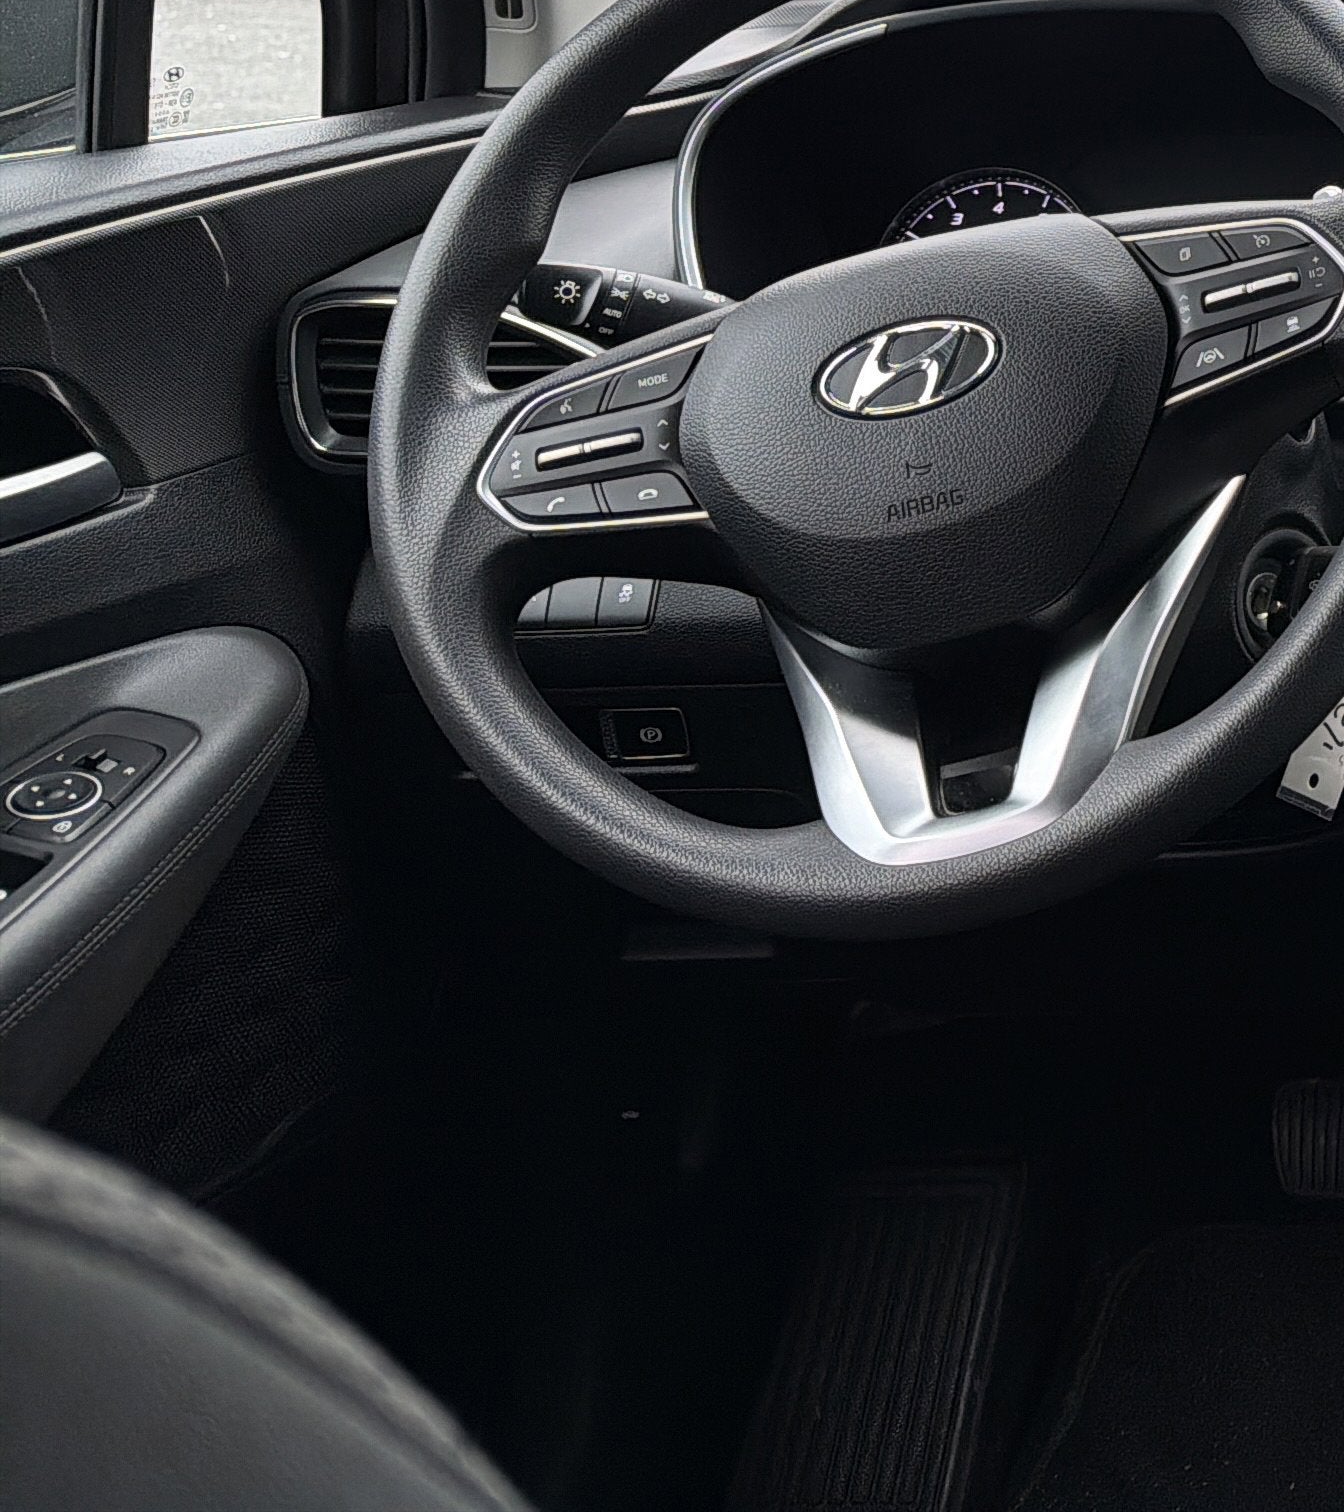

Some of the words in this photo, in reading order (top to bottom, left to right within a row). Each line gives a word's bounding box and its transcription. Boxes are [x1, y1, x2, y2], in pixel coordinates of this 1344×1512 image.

[992, 201, 1005, 215] 4
[950, 213, 964, 226] 3
[602, 307, 622, 318] AUTO
[1179, 304, 1190, 314] OK
[598, 326, 614, 335] OFF
[637, 373, 669, 388] MODE
[887, 488, 964, 523] AIRBAG
